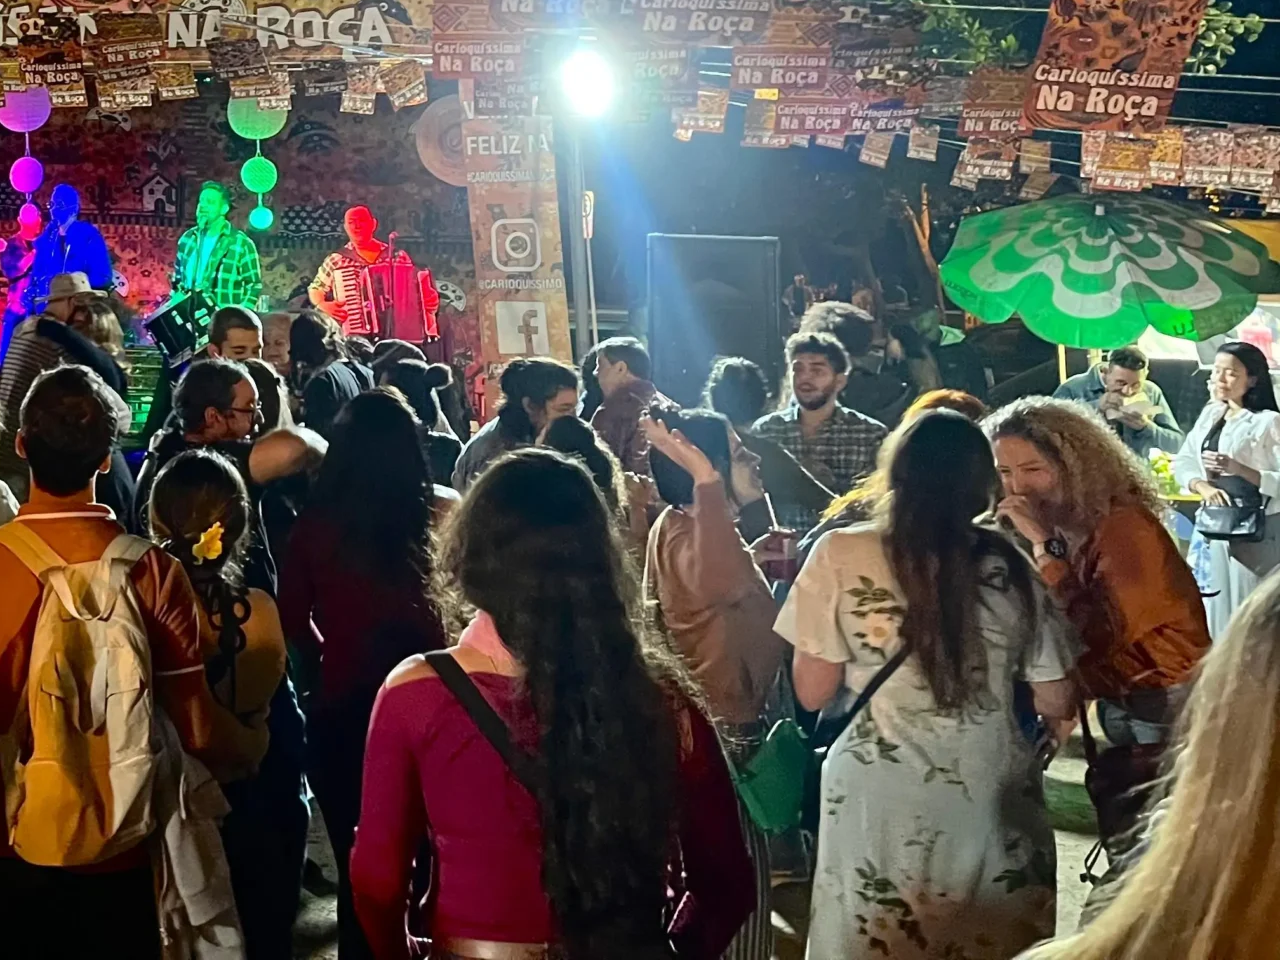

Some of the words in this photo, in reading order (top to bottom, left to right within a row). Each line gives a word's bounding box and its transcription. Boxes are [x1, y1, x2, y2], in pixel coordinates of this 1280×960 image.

[643, 11, 678, 32] Na
[688, 11, 755, 36] Roça
[107, 53, 124, 63] Na
[128, 48, 160, 61] Roça
[440, 56, 463, 72] Na
[470, 56, 515, 76] Roça
[25, 72, 42, 83] Na
[47, 71, 78, 83] Roça
[738, 68, 763, 84] Na
[771, 68, 819, 88] Roça
[1035, 64, 1175, 89] Carioquíssima
[1036, 85, 1073, 112] Na
[1085, 87, 1159, 121] Roça
[780, 116, 799, 130] Na
[805, 116, 841, 132] Roça
[852, 118, 870, 130] Na
[876, 117, 912, 131] Roça
[964, 118, 984, 132] Na
[467, 135, 522, 156] FELIZ
